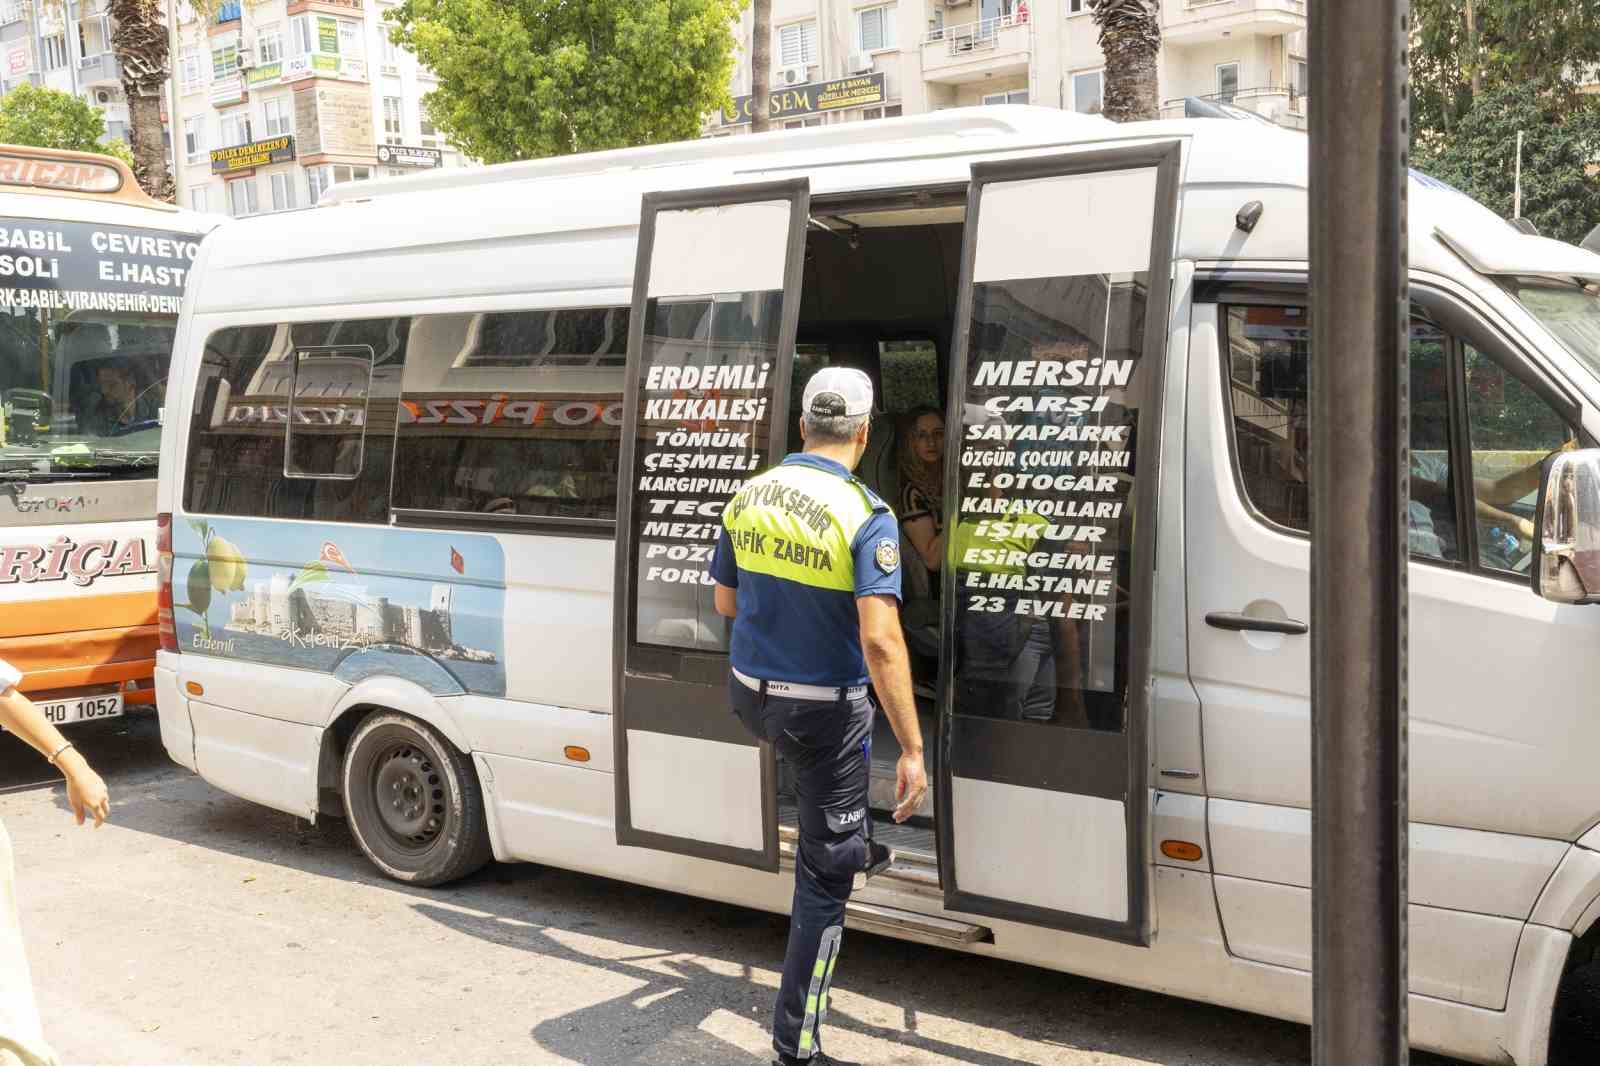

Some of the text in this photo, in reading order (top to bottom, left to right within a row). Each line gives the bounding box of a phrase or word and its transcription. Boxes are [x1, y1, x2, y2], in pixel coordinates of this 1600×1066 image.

[984, 396, 1110, 417] ÇARŞI
[655, 428, 750, 448] TÖMÜK
[965, 425, 1128, 442] SAYAPARK
[962, 447, 1131, 471] ÖZGÜR ÇOCUK PARKI
[639, 476, 748, 494] KARGIPINA
[968, 472, 1119, 492] E.OTOGAR
[733, 479, 832, 539] BÜYÜKŞEHİR
[961, 497, 1123, 519] KARAYOLLARI
[774, 538, 832, 571] ZABITA
[965, 572, 1112, 596] E.HASTANE
[967, 595, 1107, 621] 23 EVLER
[77, 698, 118, 720] 1052
